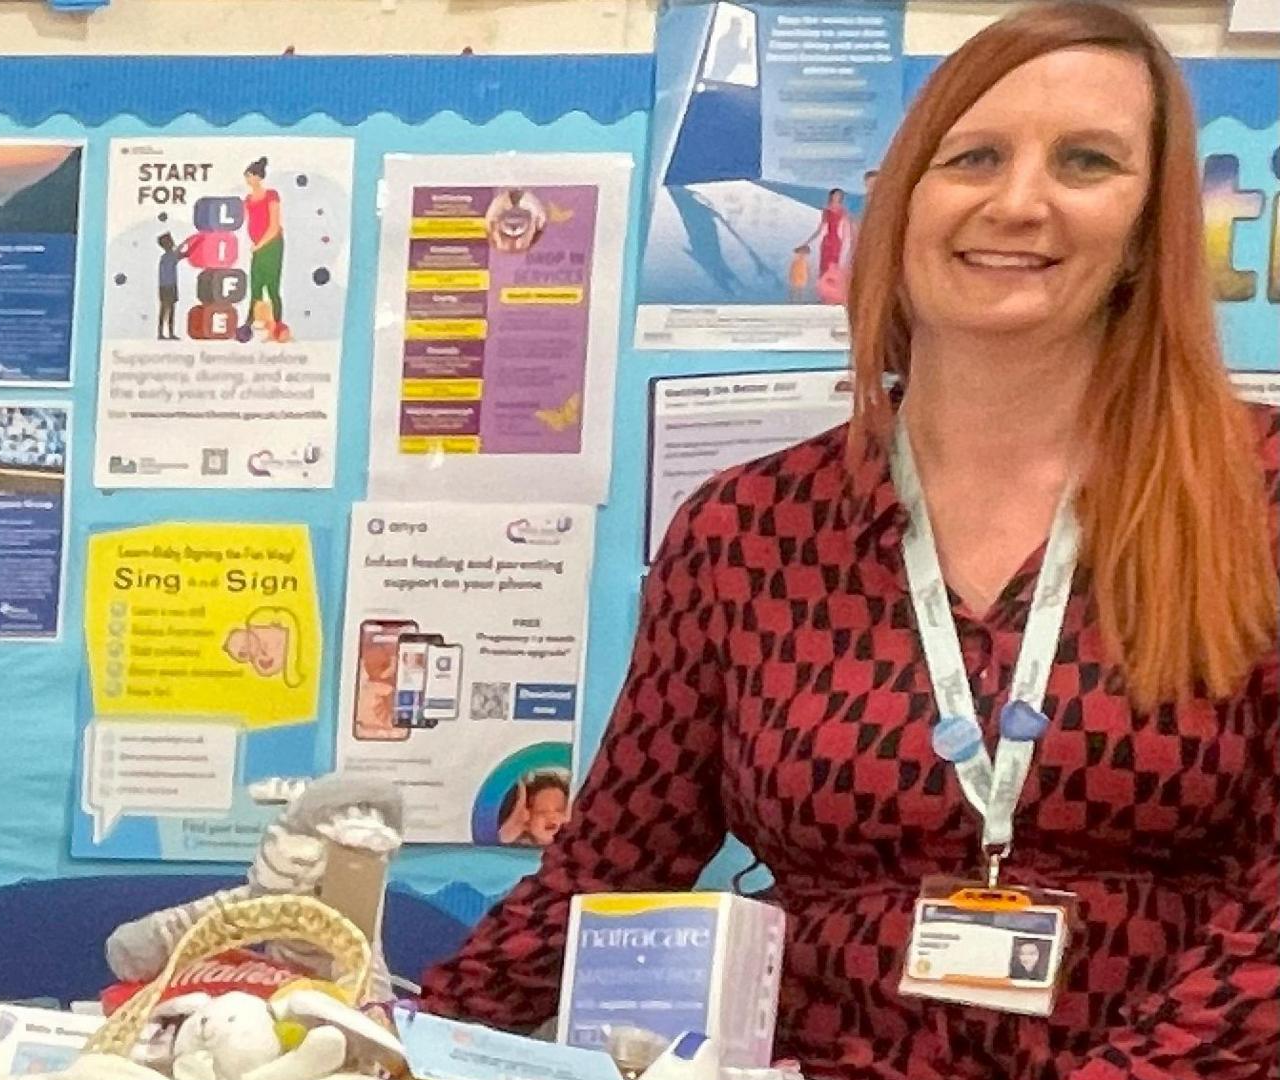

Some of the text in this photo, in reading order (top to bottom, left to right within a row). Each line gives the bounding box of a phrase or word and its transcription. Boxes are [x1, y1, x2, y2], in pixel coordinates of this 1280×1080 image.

[138, 163, 213, 182] START
[138, 186, 187, 205] FOR
[111, 349, 308, 367] Supporting families before
[110, 387, 133, 400] the
[138, 386, 173, 402] early
[177, 389, 216, 402] years
[240, 386, 315, 400] childhood
[365, 554, 564, 575] Infant feeding and parenting
[113, 566, 182, 595] Sing
[226, 569, 299, 596] Sign
[384, 576, 543, 593] support on your phone
[580, 926, 712, 949] natracare
